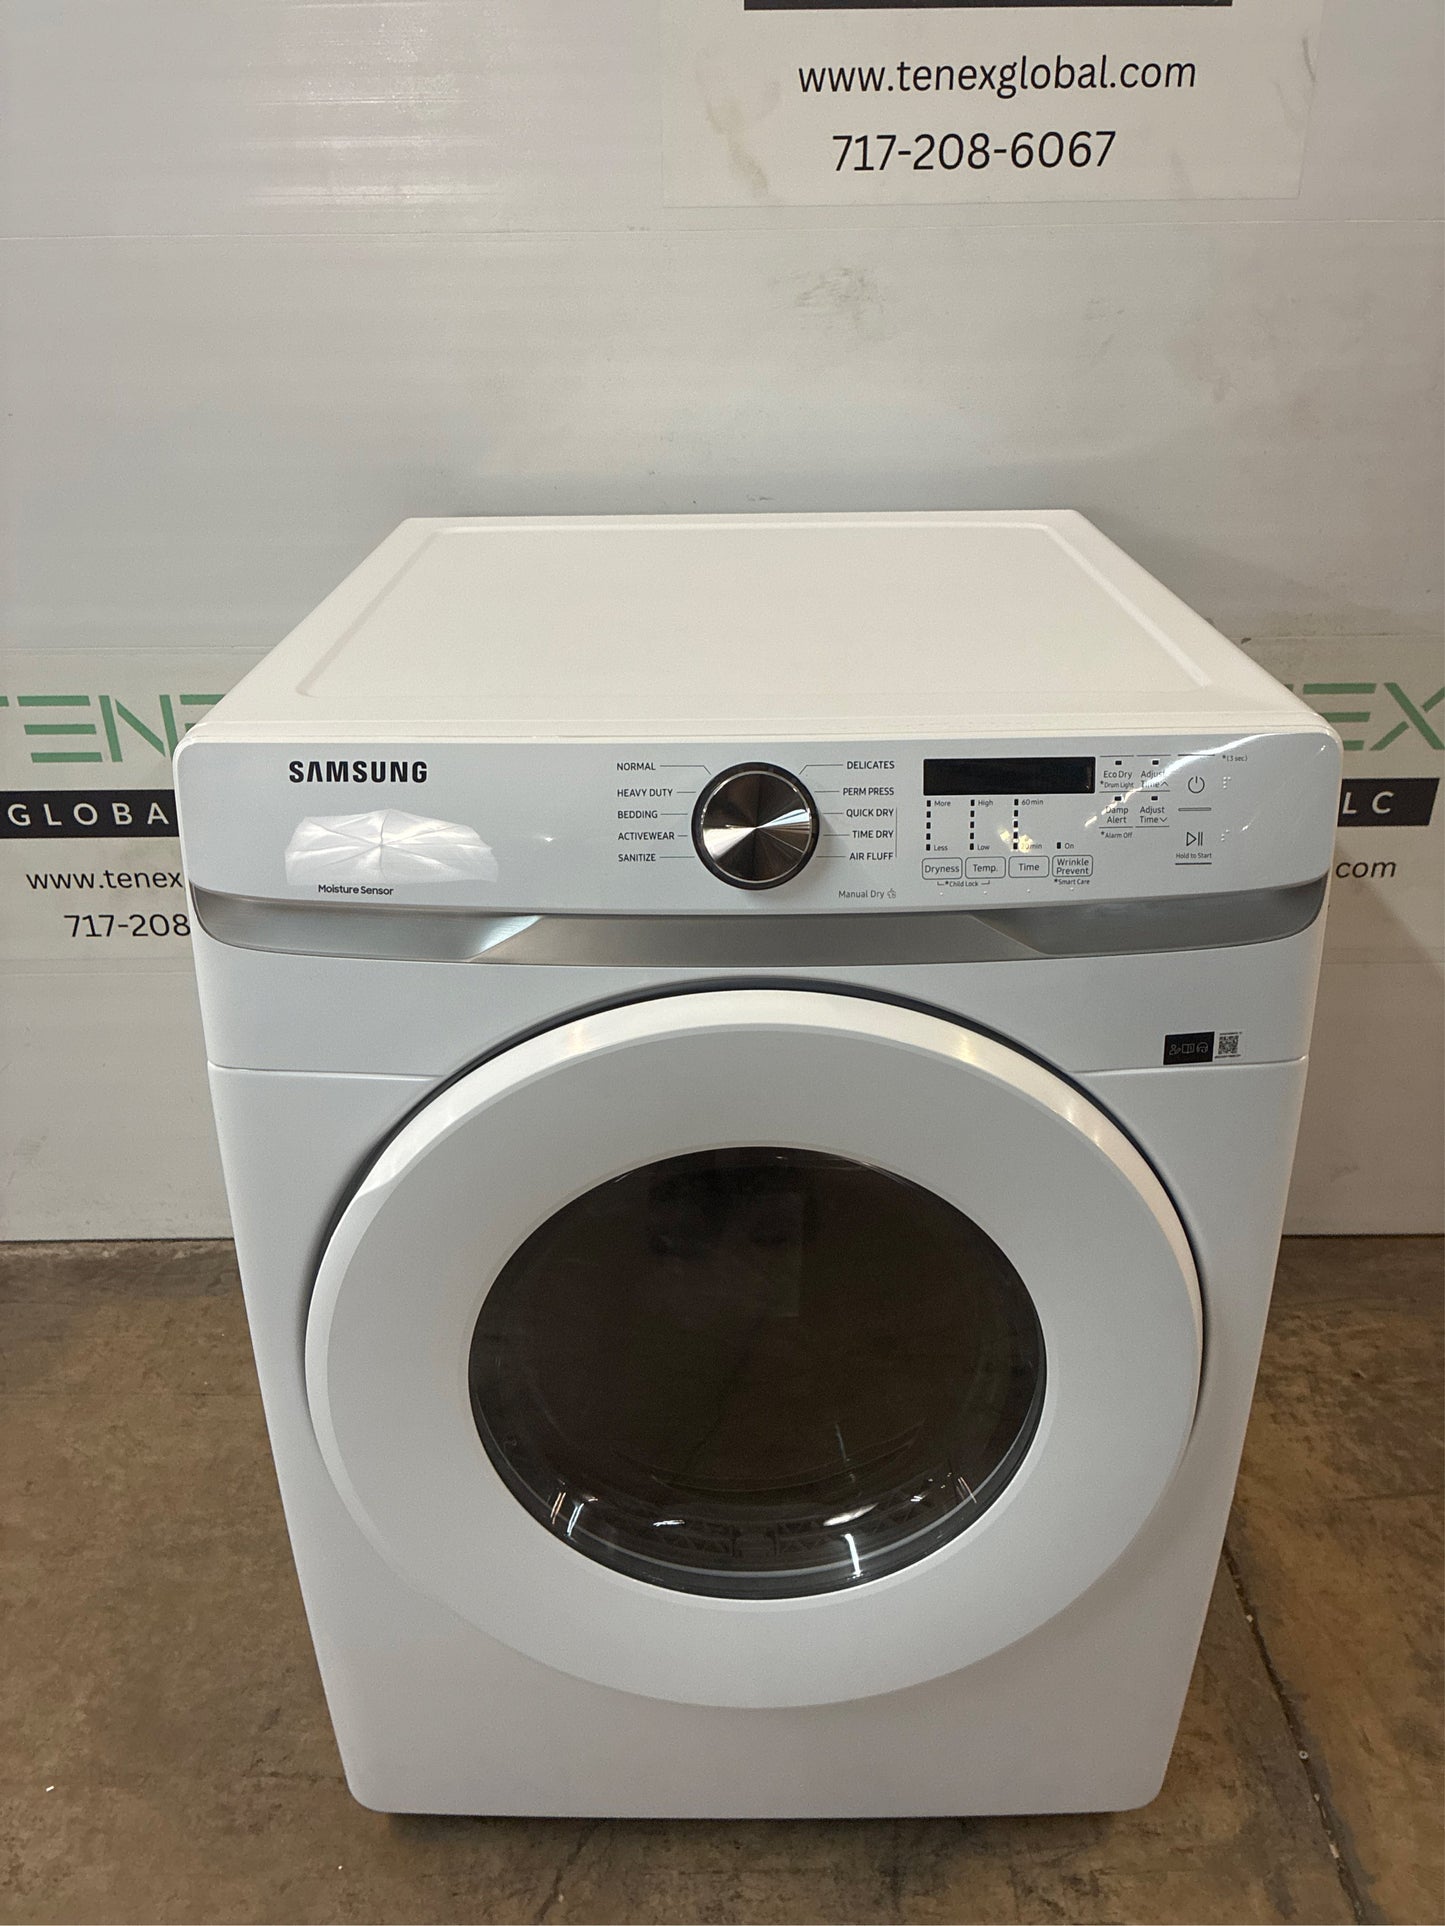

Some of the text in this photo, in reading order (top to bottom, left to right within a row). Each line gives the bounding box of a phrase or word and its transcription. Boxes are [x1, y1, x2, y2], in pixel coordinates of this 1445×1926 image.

[799, 55, 1197, 99] www.tenexglobal.com
[832, 130, 1117, 172] 717-208-6067
[616, 761, 657, 772] NORMAL
[846, 760, 896, 770] DELICATES
[288, 760, 429, 784] SAMSUNG
[1103, 770, 1133, 780] Eco Dry
[1120, 781, 1134, 790] Light
[616, 788, 674, 798] HEAVY DUTY
[842, 786, 895, 797] PERM PRESS
[977, 799, 994, 807] High
[7, 801, 170, 827] GLOBA
[617, 809, 658, 820] BEDDING
[846, 808, 894, 819] QUICK DRY
[1105, 805, 1129, 816] Damp
[1139, 806, 1165, 815] Adjust
[1106, 816, 1127, 824] Alert
[1139, 816, 1159, 824] Time
[617, 831, 675, 841] ACTIVEWEAR
[852, 829, 894, 840] TIME DRY
[933, 844, 949, 852] Less
[1064, 842, 1075, 850] On
[617, 853, 657, 863] SANITIZE
[849, 851, 894, 861] AIR FLUFF
[1056, 857, 1090, 867] Wrinkle
[924, 864, 960, 876] Dryness
[972, 863, 999, 874] Temp.
[1018, 863, 1041, 872] Time
[1056, 866, 1090, 876] Prevent
[26, 869, 184, 890] www.tenex
[317, 883, 395, 896] Moisture Sensor
[838, 889, 885, 901] Manual Dry
[63, 913, 191, 938] 717-208
